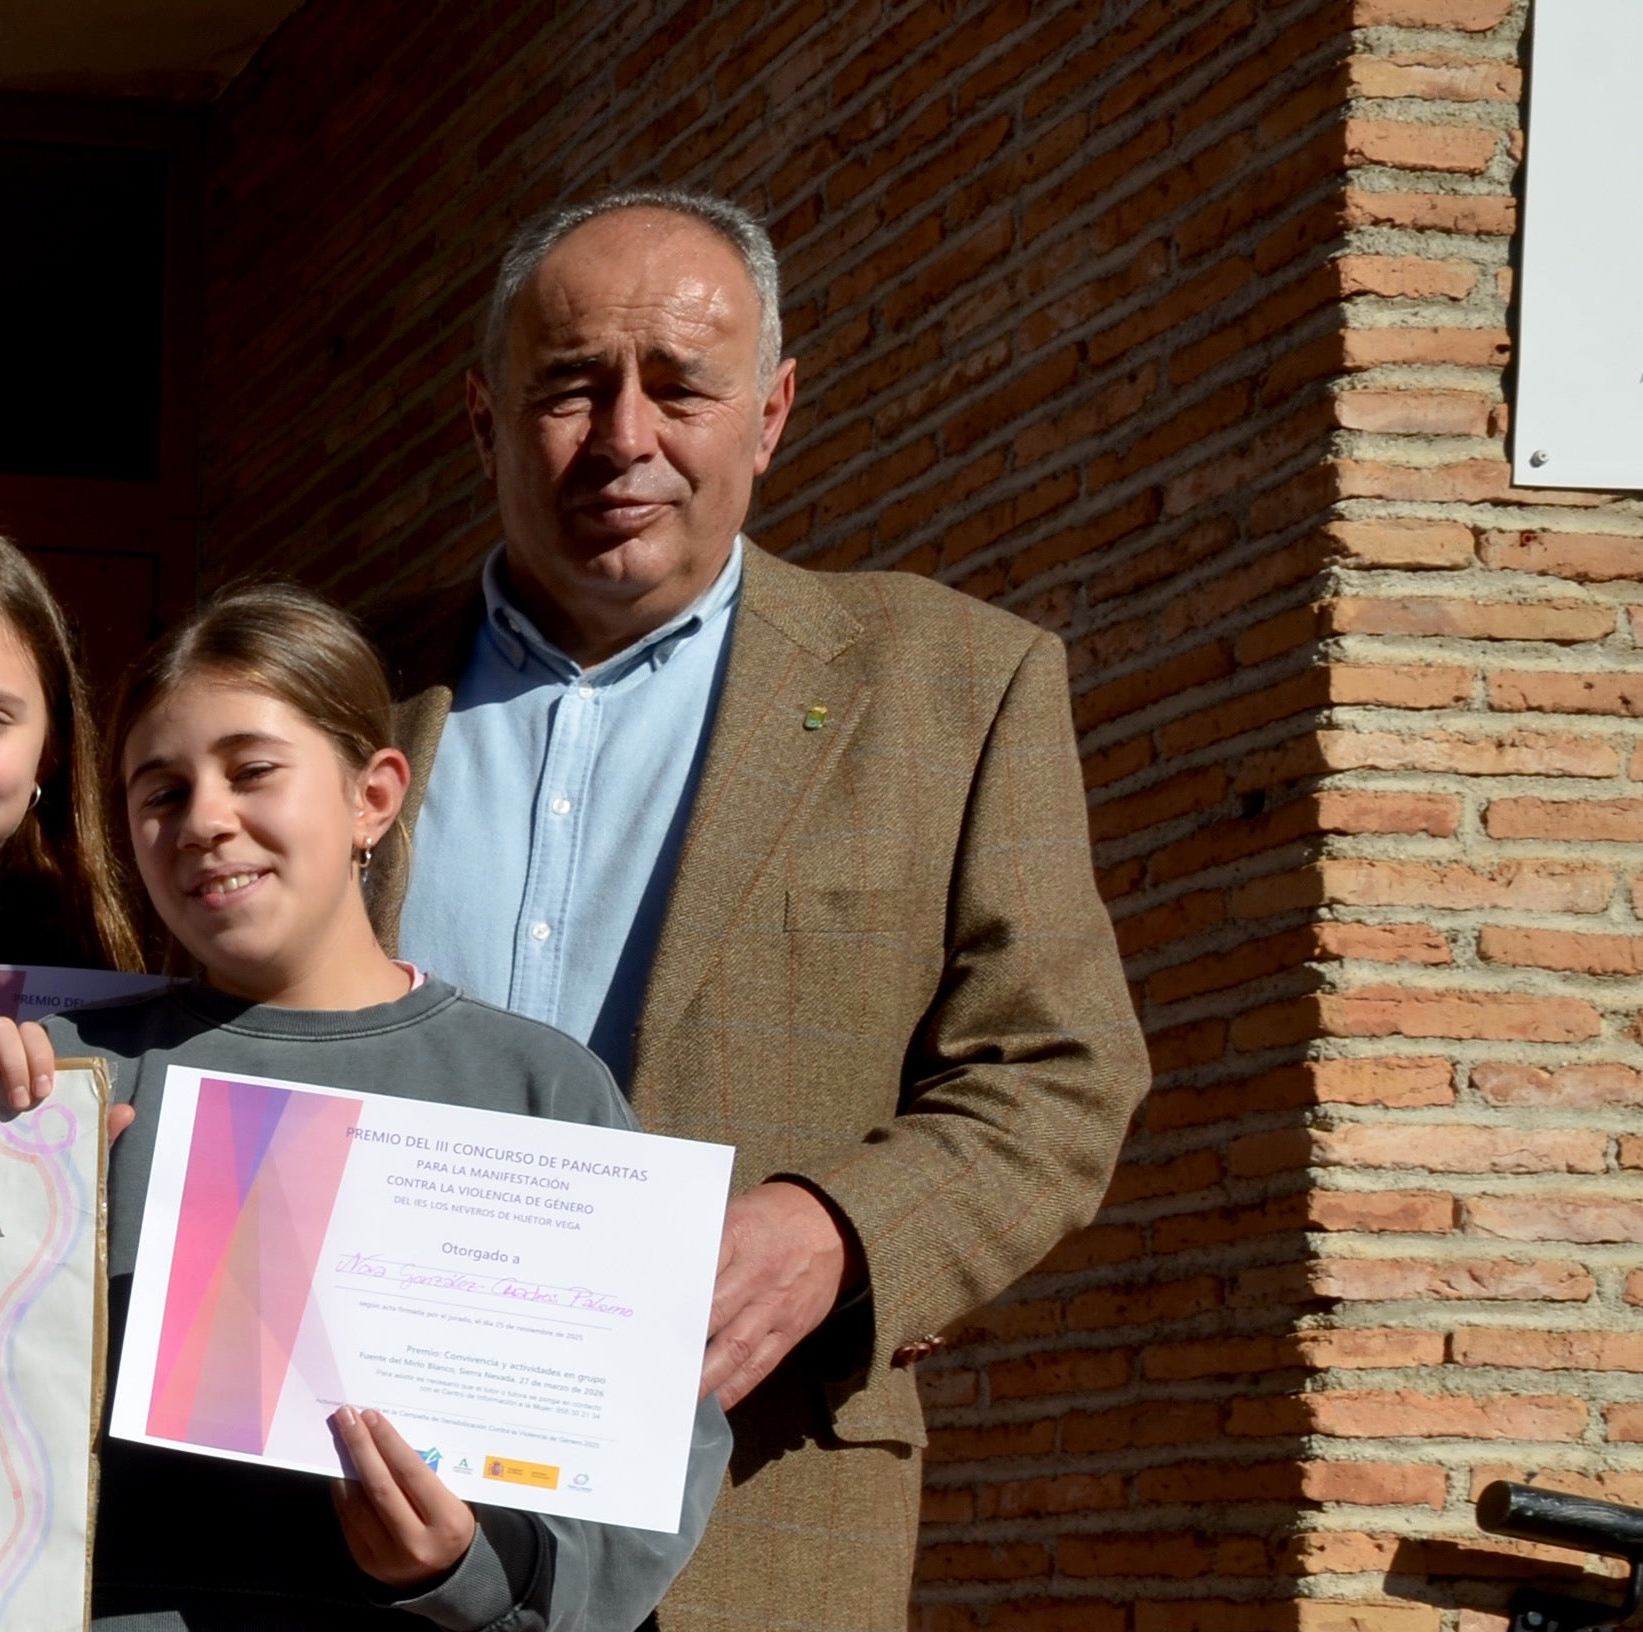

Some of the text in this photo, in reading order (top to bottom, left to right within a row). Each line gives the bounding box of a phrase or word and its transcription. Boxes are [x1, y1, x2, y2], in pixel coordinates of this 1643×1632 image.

[13, 993, 60, 1007] PREMIO
[346, 1126, 650, 1182] PREMIO DEL III CONCURSO DE PANCARTAS
[416, 1159, 572, 1191] PARA LA MANIFESTACIÓN
[386, 1175, 596, 1215] CONTRA LA VIOLENCIA DE GÉNERO
[441, 1242, 522, 1266] Otorgado a
